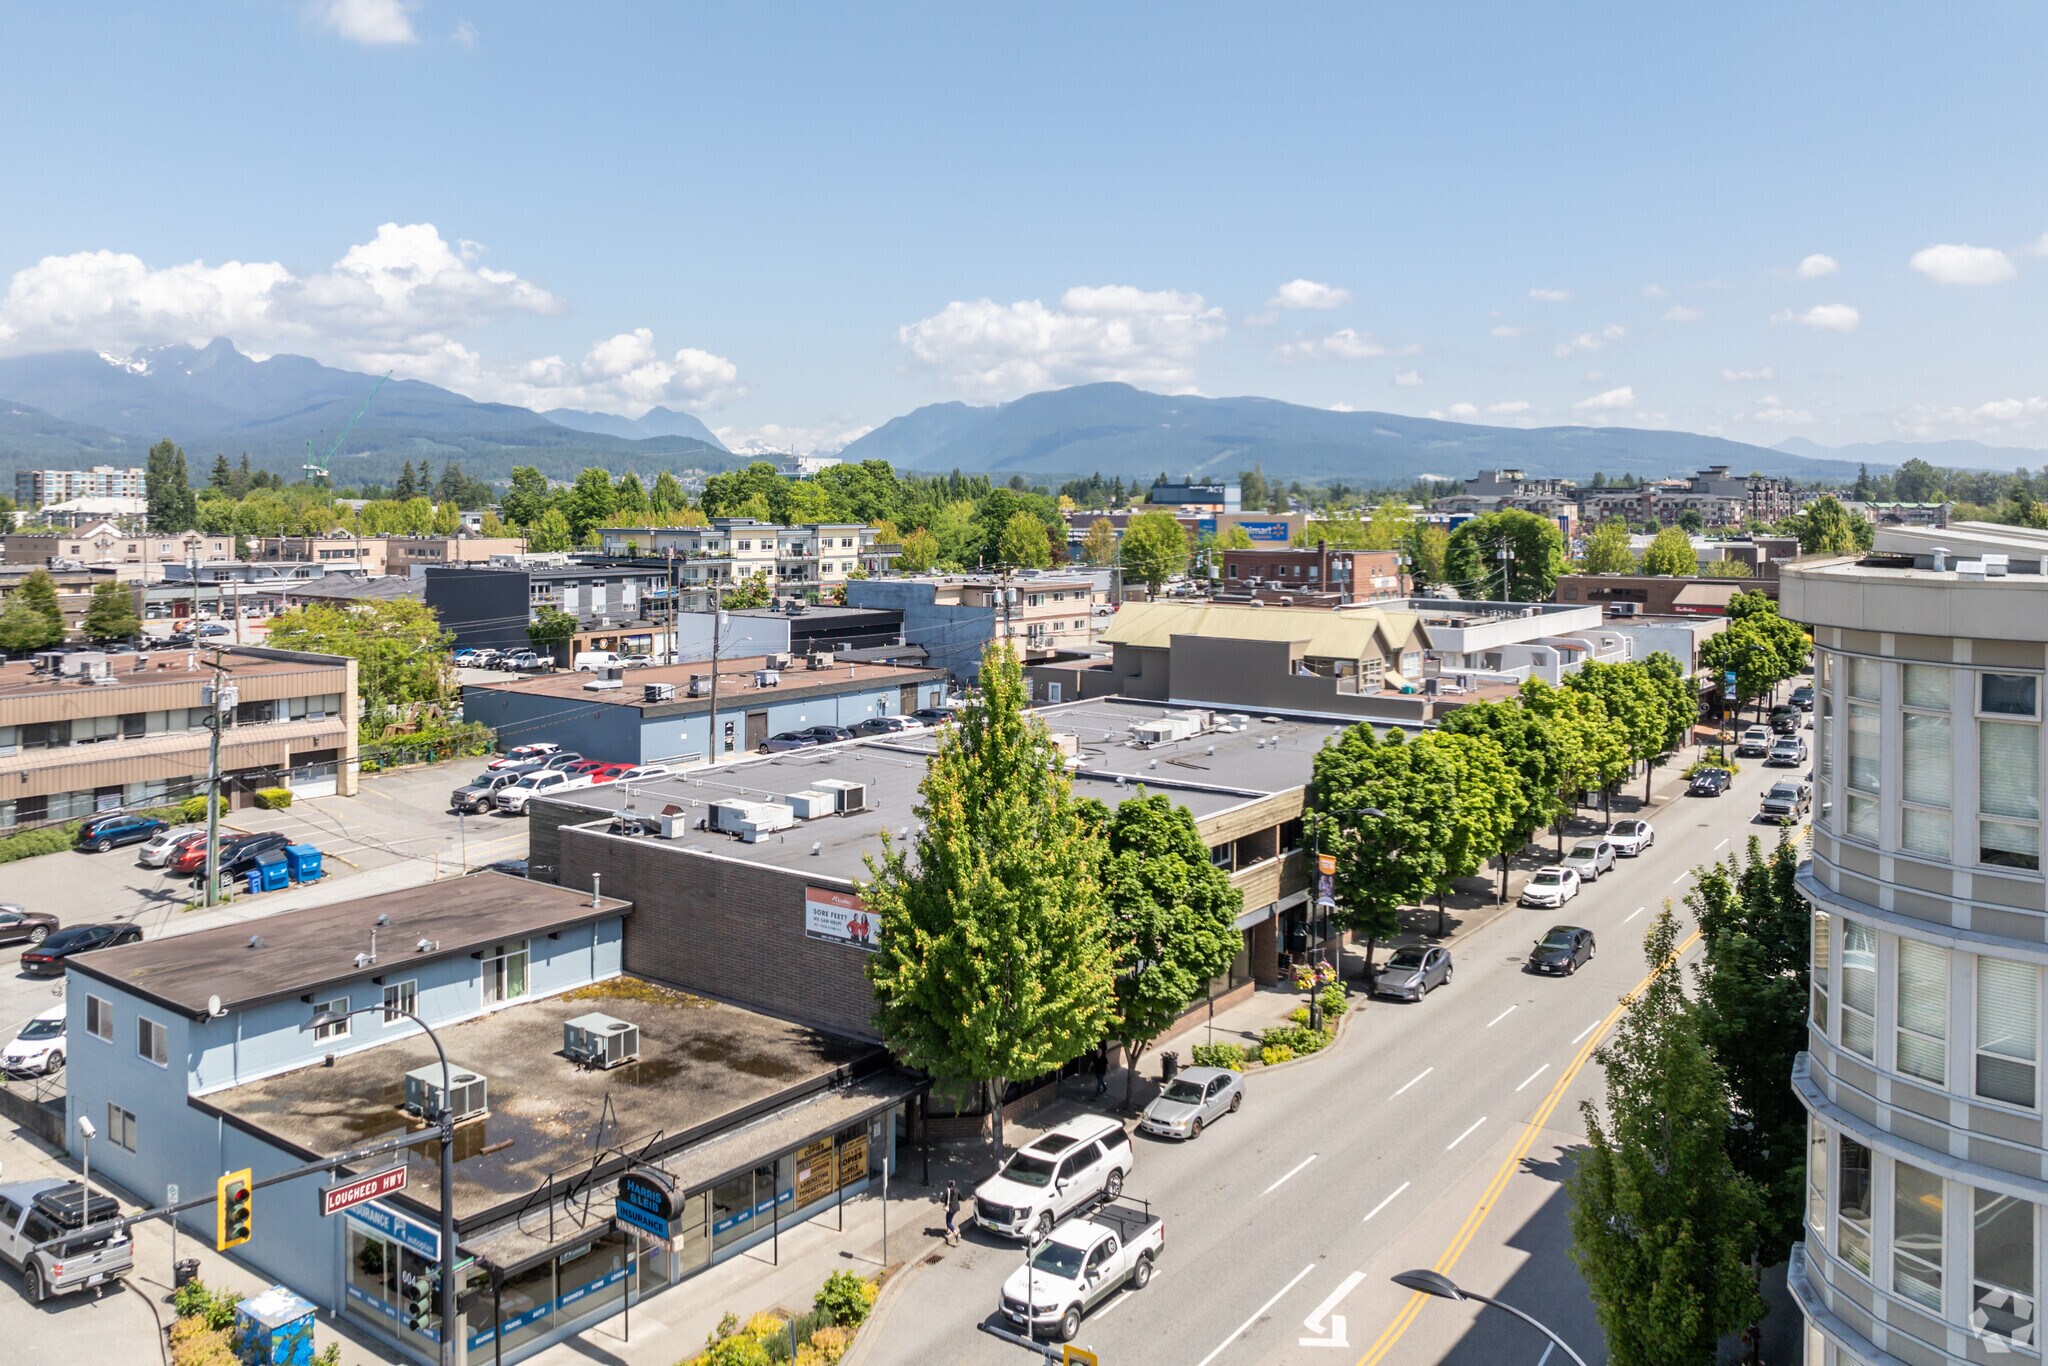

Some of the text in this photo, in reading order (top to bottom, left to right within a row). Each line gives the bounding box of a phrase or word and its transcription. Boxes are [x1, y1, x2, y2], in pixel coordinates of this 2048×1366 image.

[813, 908, 848, 921] SORE FEET?
[804, 1142, 824, 1157] COPIES
[329, 1172, 404, 1208] LOUGHEED HWY
[627, 1180, 662, 1204] HARRIS
[620, 1207, 664, 1232] INSURANCE
[407, 1236, 434, 1254] autoplan
[505, 1318, 522, 1331] TRAVEL
[532, 1307, 546, 1319] AUTO
